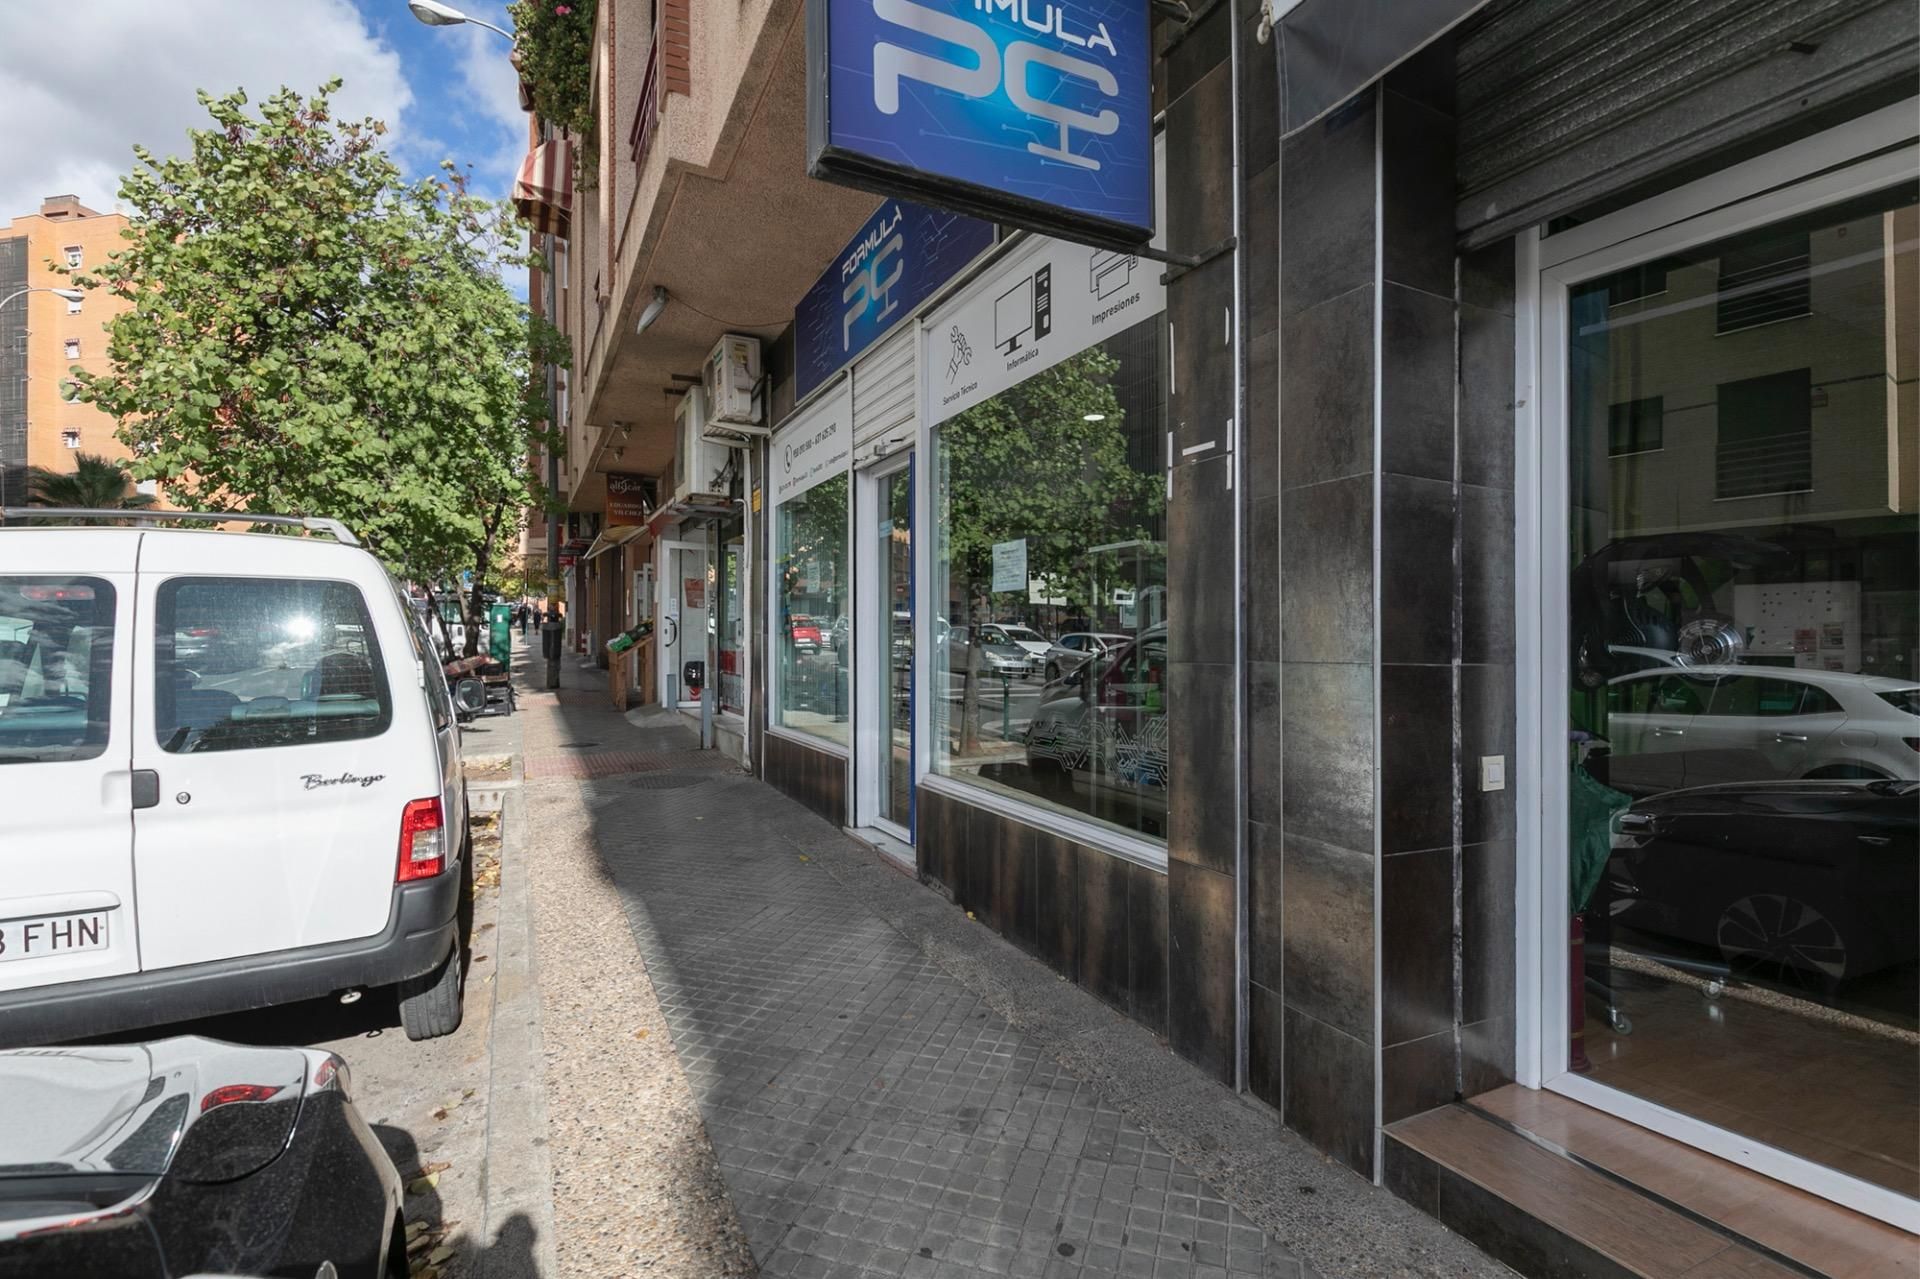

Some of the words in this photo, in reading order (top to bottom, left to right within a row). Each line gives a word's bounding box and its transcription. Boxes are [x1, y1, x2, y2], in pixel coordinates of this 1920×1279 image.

[975, 0, 1117, 56] MULA
[842, 205, 902, 283] FORMULA
[1092, 292, 1141, 326] Impresiones
[1006, 348, 1039, 372] Informática
[942, 390, 960, 406] Servicio
[960, 381, 978, 397] Técnico
[300, 772, 386, 791] Berlingo
[23, 916, 99, 953] FHN
